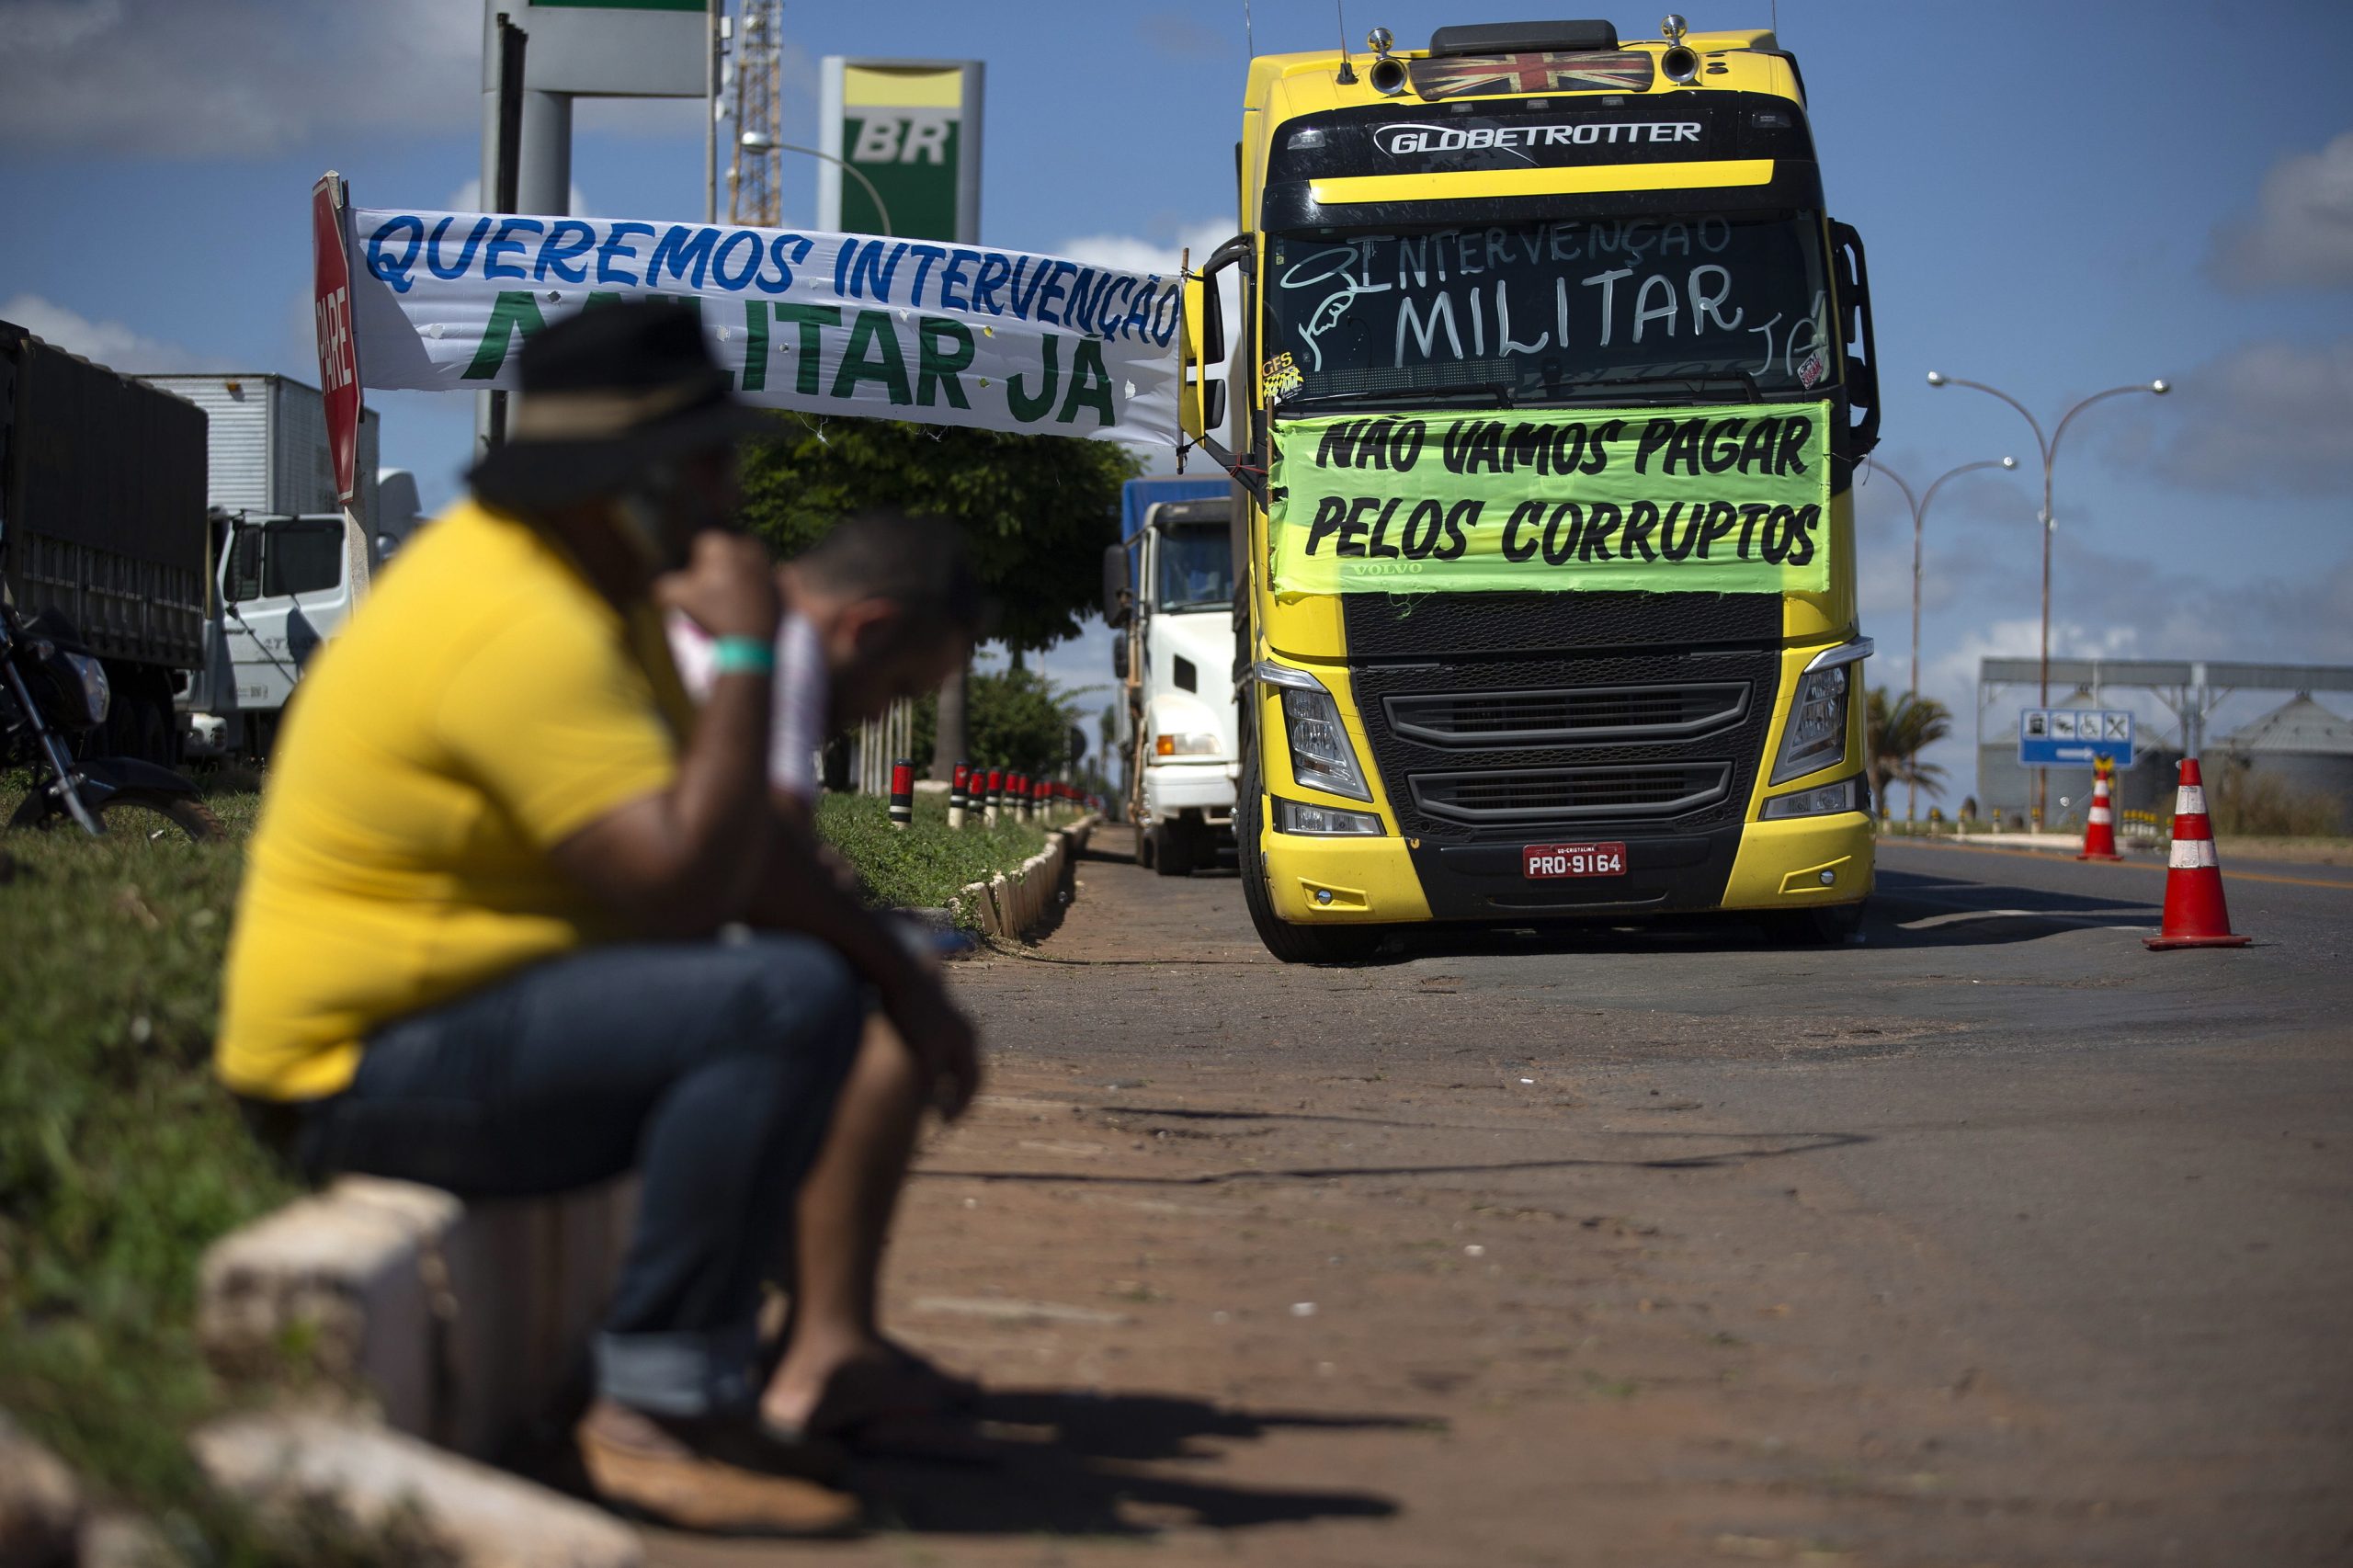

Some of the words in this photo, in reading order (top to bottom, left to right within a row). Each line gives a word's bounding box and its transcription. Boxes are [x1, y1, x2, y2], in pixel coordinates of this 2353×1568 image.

[852, 116, 950, 165] BR
[1390, 121, 1701, 155] GLOBETROTTER
[367, 215, 815, 294] QUEREMOS
[835, 237, 1180, 348] INTERVENÇÃO
[316, 286, 352, 396] PARE
[1394, 265, 1744, 369] MILITAR
[1315, 415, 1427, 472] NÃO
[1443, 419, 1629, 476] VAMOS
[1634, 415, 1813, 477] PAGAR
[1305, 496, 1486, 561] PELOS
[1502, 500, 1822, 566] CORRUPTOS
[1352, 562, 1423, 575] VOLVO
